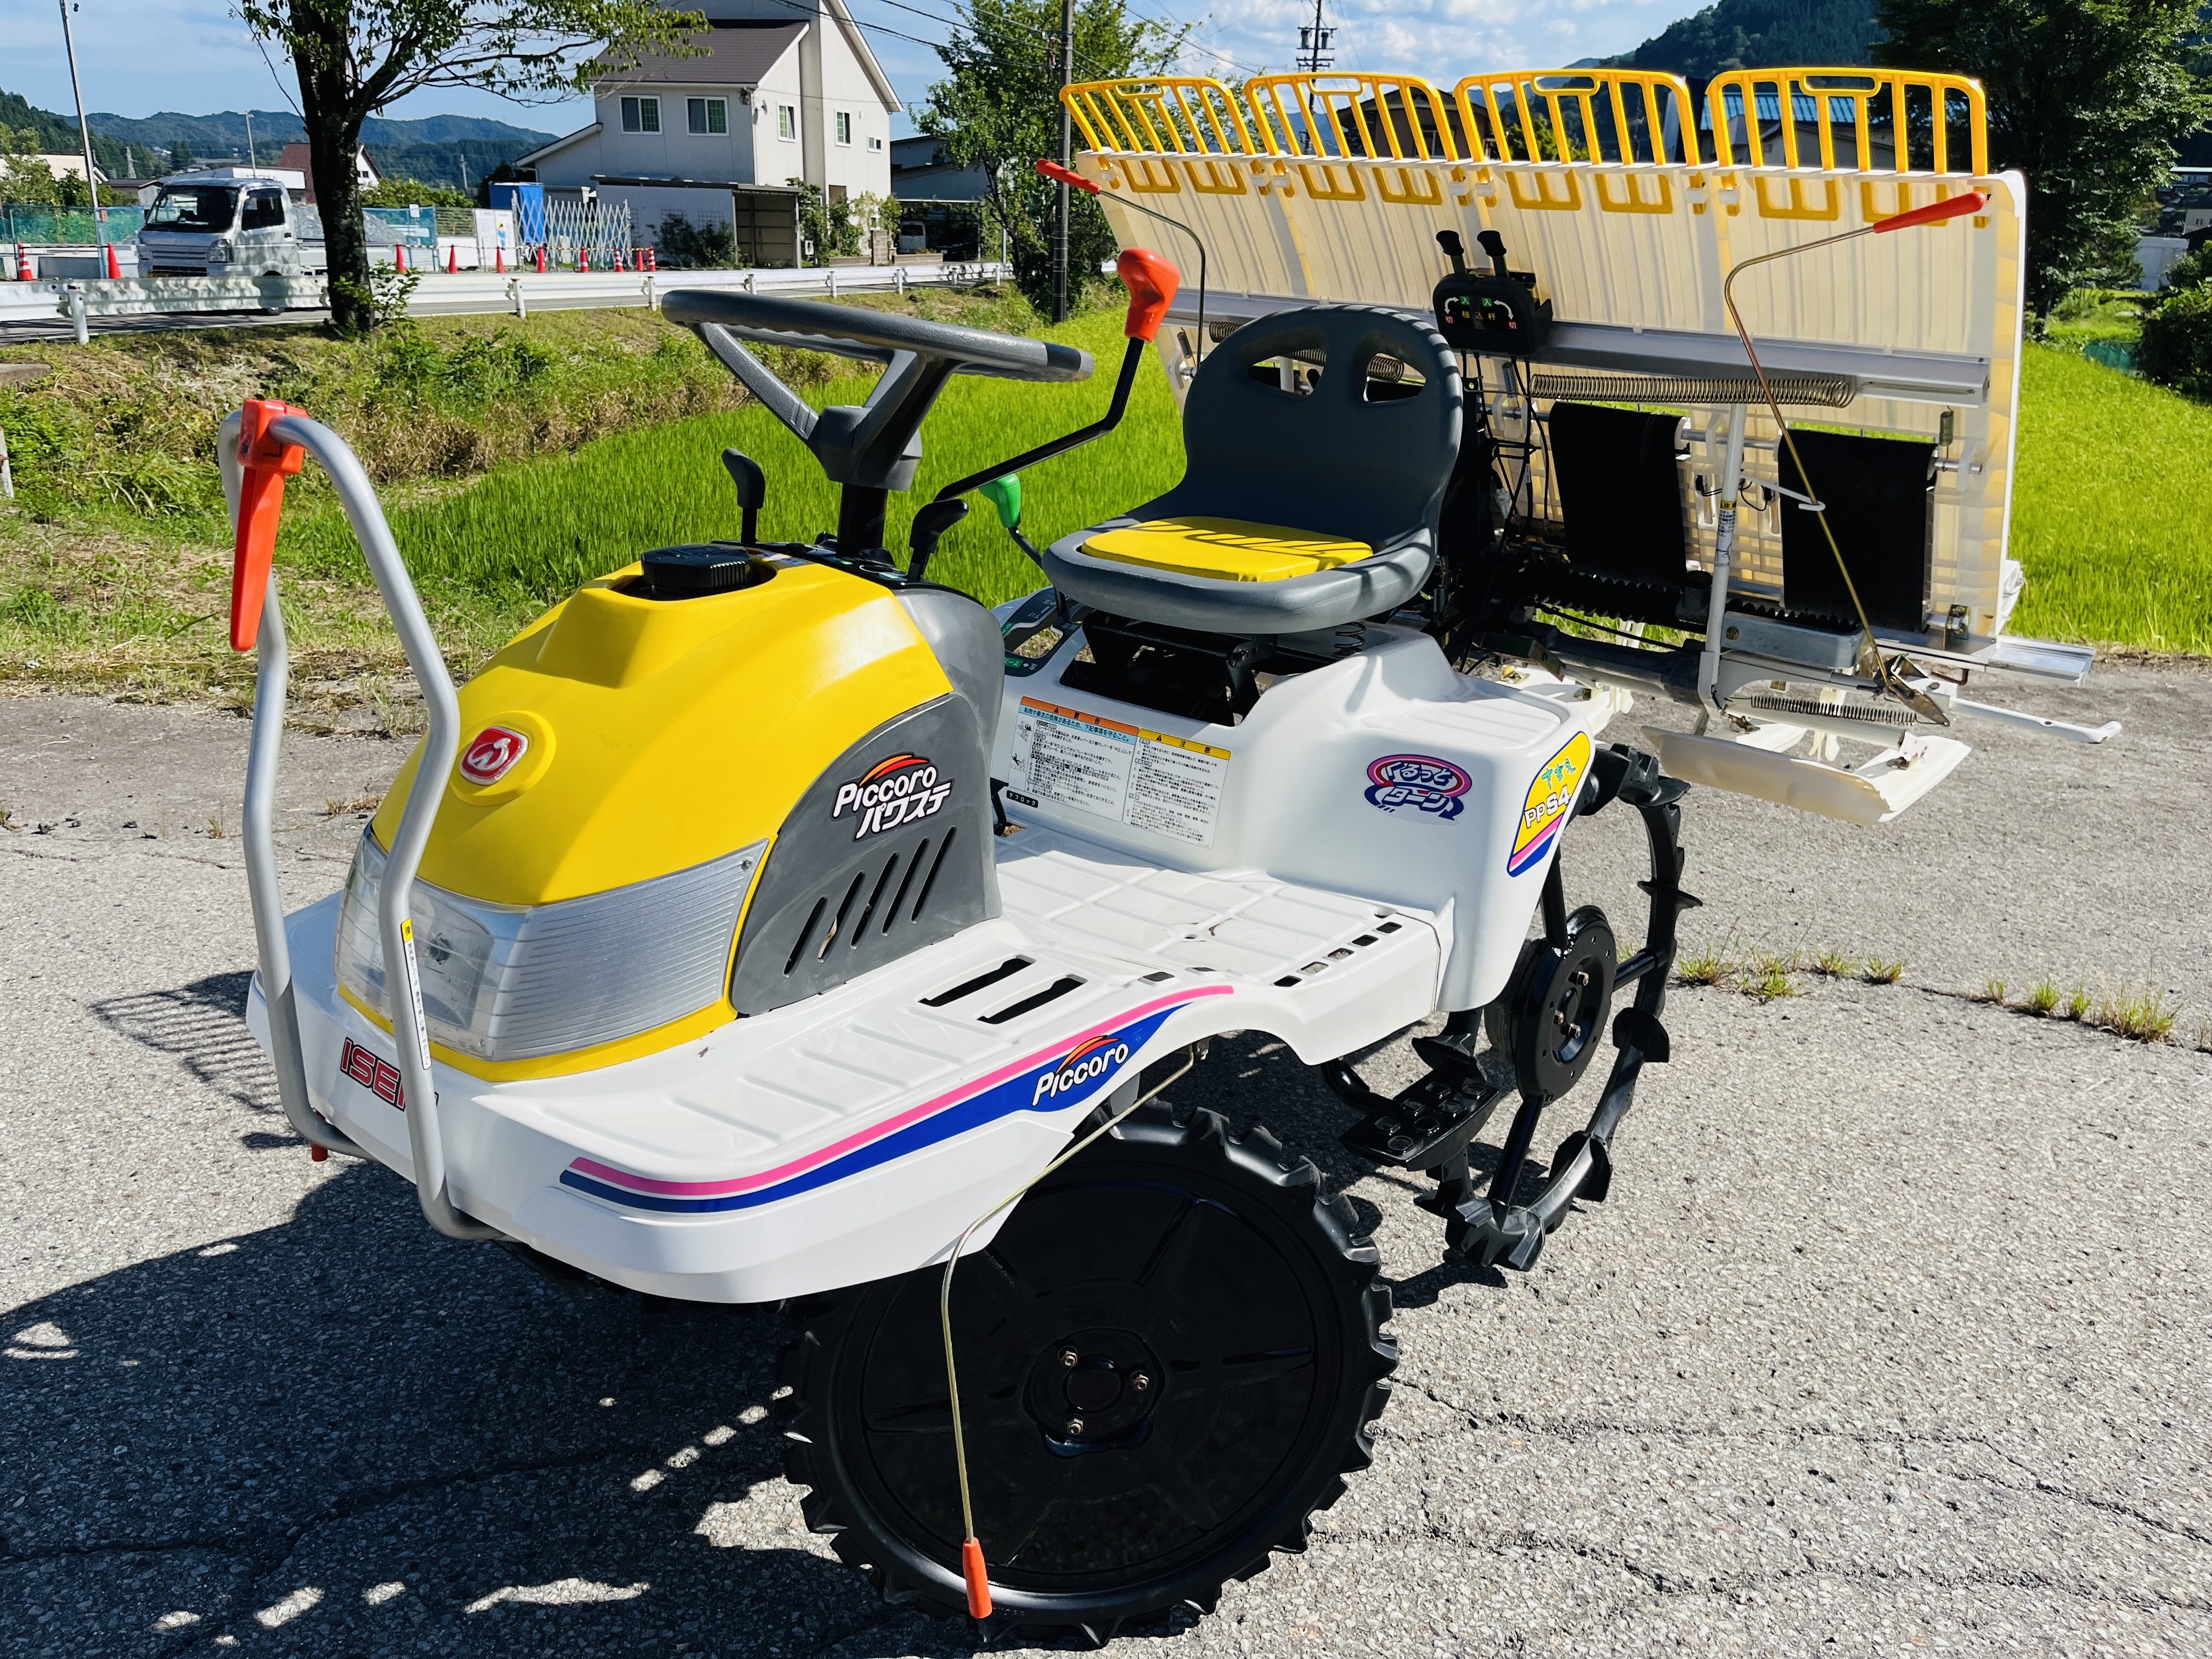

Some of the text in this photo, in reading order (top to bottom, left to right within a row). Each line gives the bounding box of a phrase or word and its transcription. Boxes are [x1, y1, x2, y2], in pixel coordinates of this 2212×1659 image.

[1180, 740, 1211, 754] 注意
[833, 766, 937, 817] Piccoro
[1385, 761, 1453, 787] くるっと
[855, 782, 951, 839] パワステ
[1009, 792, 1036, 806] デフロック
[1381, 786, 1450, 812] ターン
[340, 1036, 439, 1112] ISE
[1032, 1043, 1129, 1107] Piccoro
